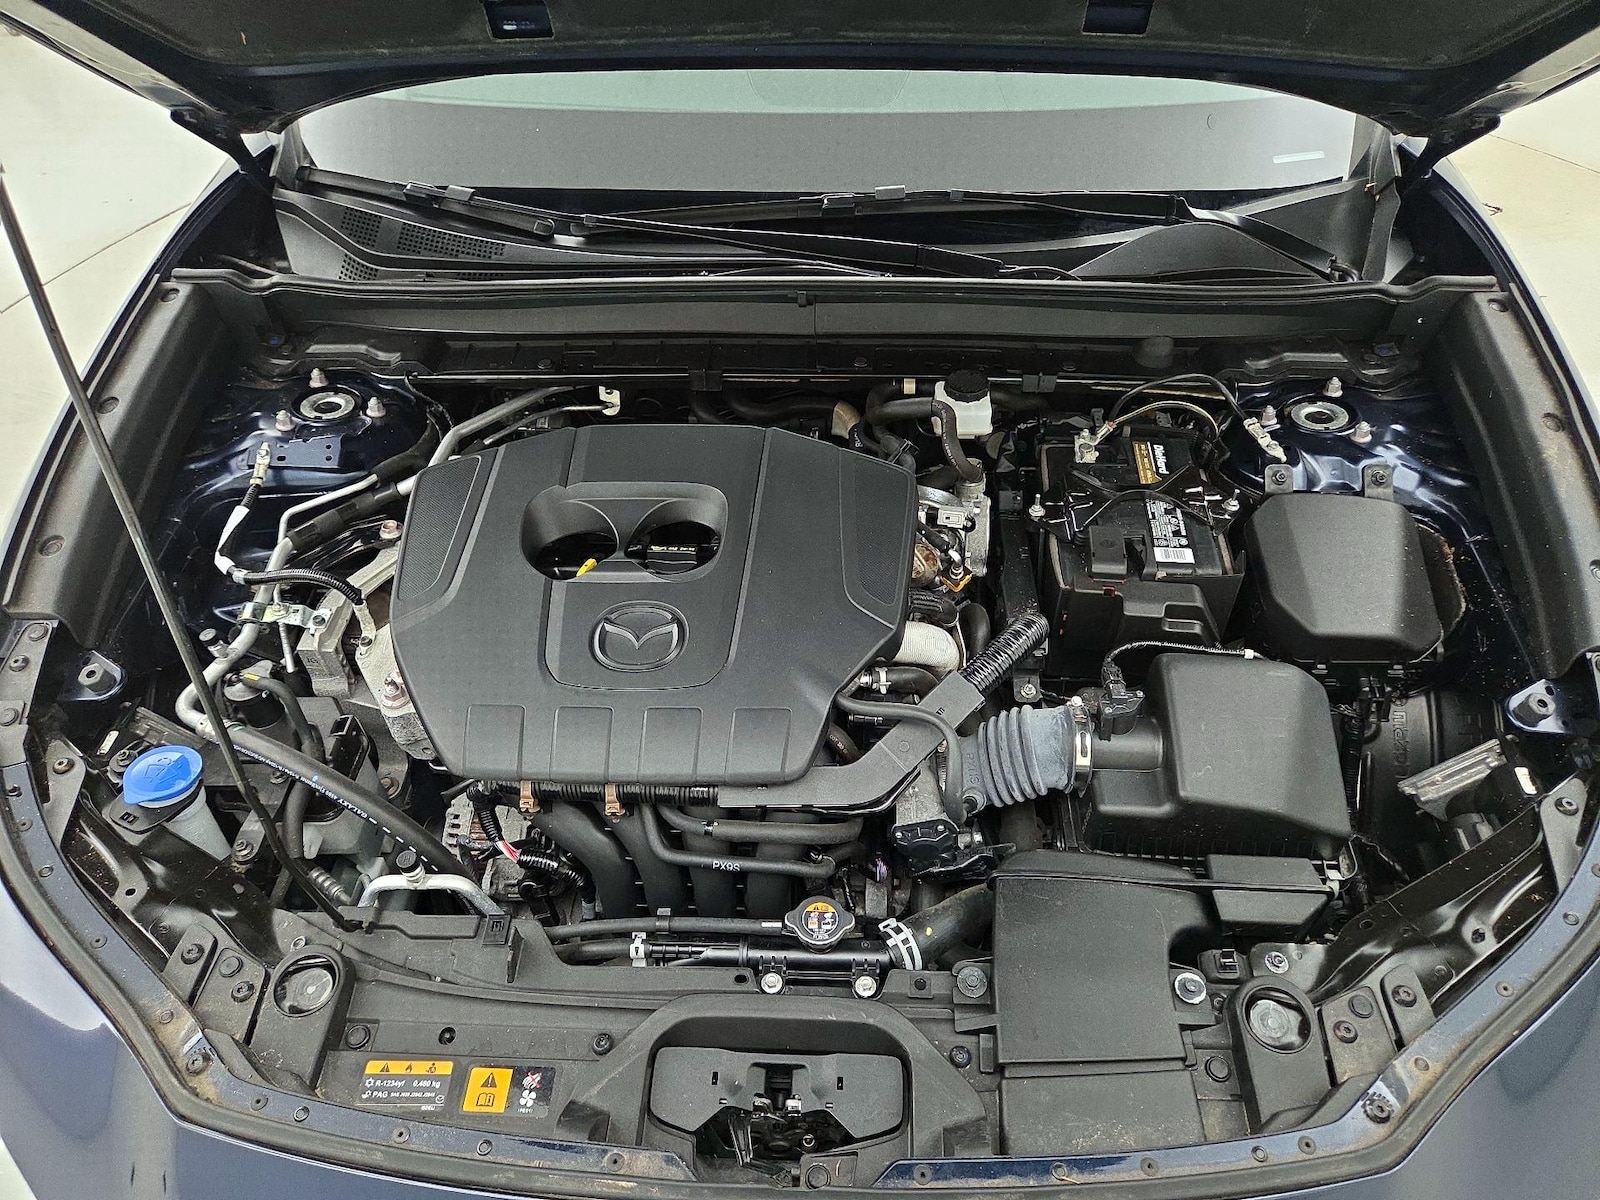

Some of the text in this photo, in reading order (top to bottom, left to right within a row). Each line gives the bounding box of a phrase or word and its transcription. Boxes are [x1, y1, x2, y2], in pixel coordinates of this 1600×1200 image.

[1153, 444, 1170, 475] DieHard
[337, 798, 368, 819] GALAXY
[712, 860, 740, 872] PX9S
[375, 1080, 406, 1089] R-1234yf
[432, 1080, 441, 1089] kg
[372, 1090, 388, 1098] PAG
